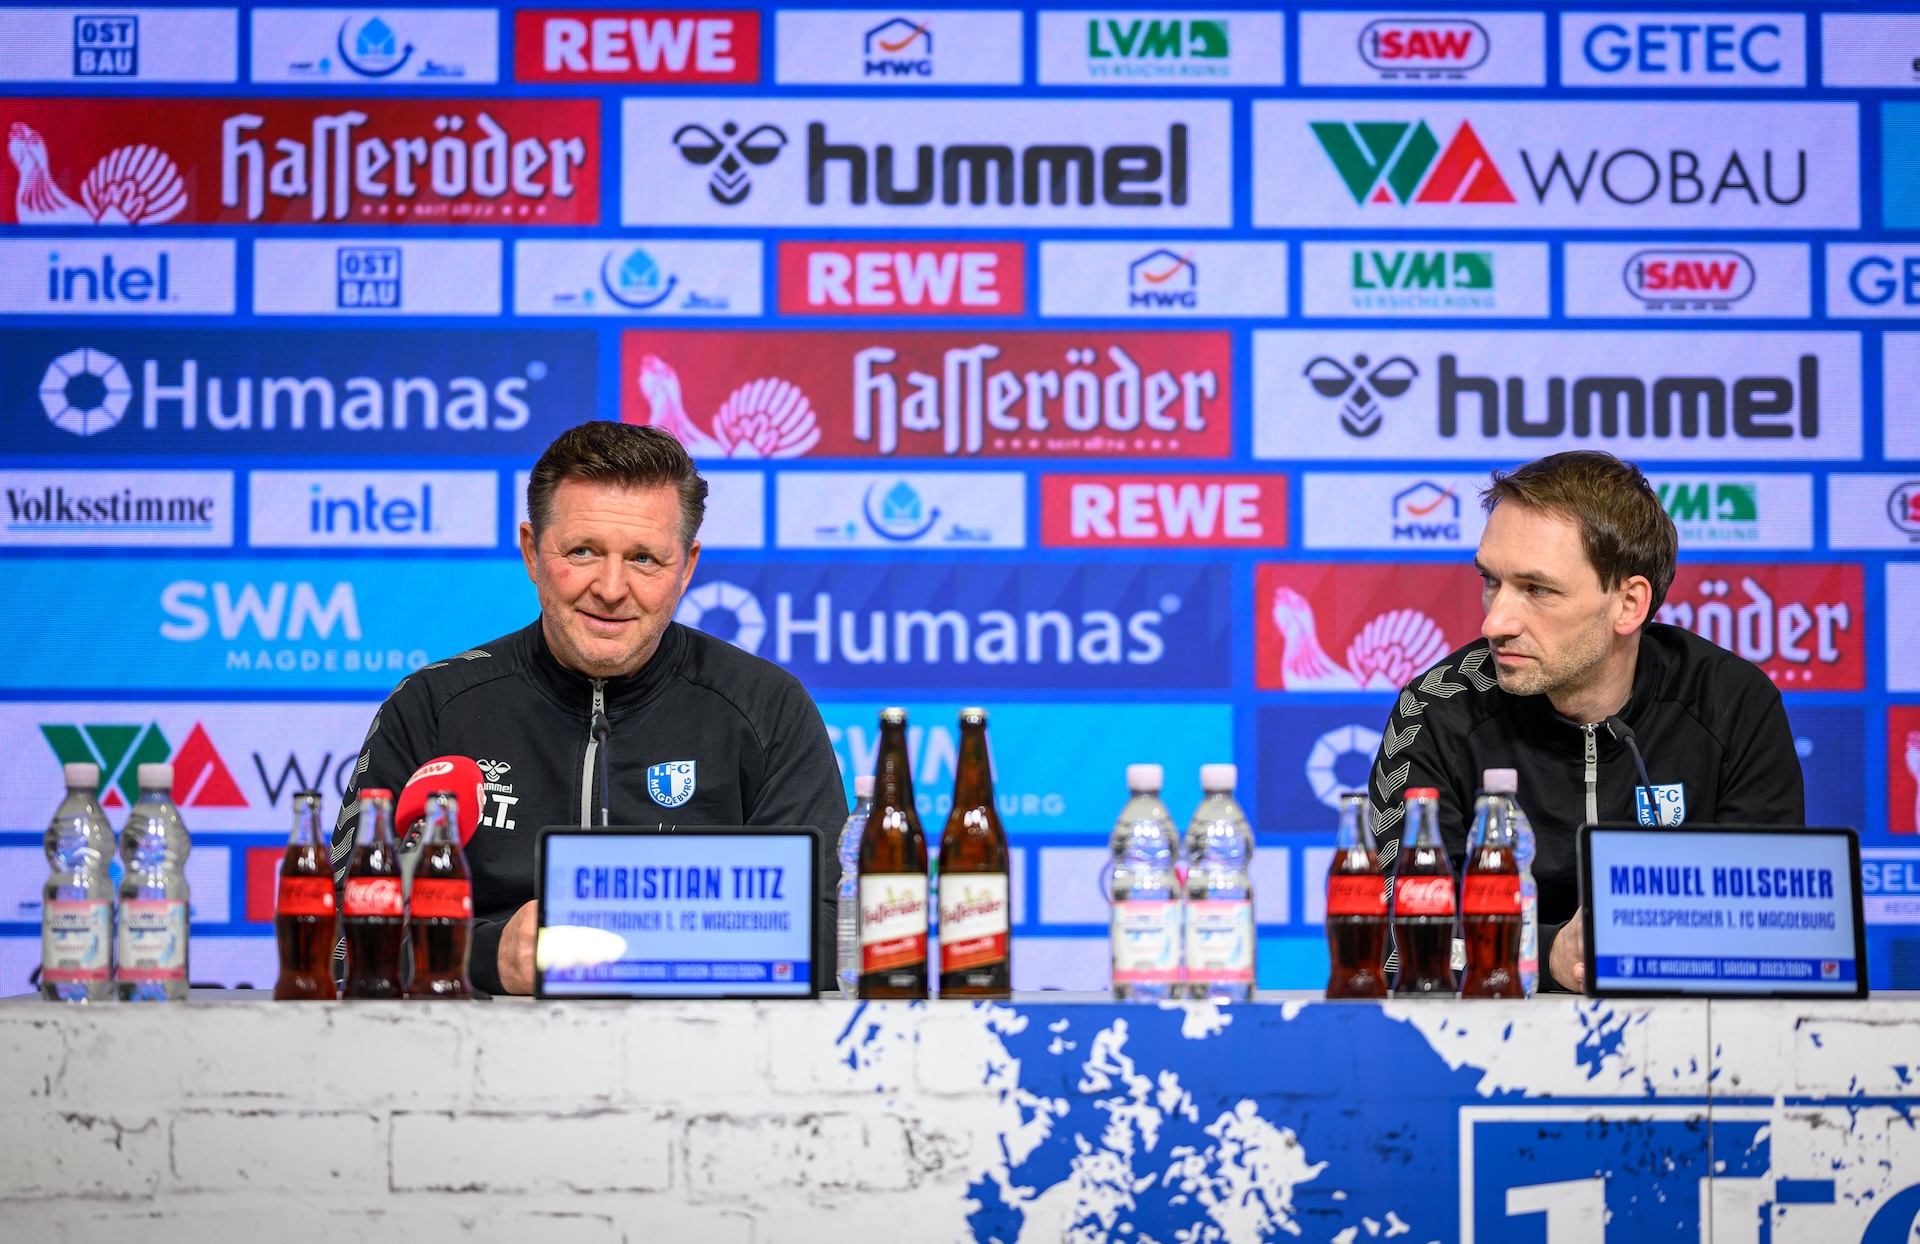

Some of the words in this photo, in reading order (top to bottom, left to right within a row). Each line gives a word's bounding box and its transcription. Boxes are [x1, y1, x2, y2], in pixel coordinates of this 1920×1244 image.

[81, 22, 131, 44] OST
[544, 18, 736, 72] REWE
[1089, 20, 1182, 58] LVM
[1582, 23, 1781, 74] GETEC
[80, 51, 133, 74] BAU
[864, 60, 932, 76] MWG
[807, 121, 1188, 206] hummel
[1519, 149, 1807, 206] WOBAU
[48, 251, 170, 302] intel
[344, 253, 392, 275] OST
[808, 252, 1000, 306] REWE
[1353, 252, 1447, 289] LVM
[341, 282, 397, 307] BAU
[1130, 291, 1197, 308] MWG
[143, 359, 531, 432] Humanas
[1437, 354, 1819, 438] hummel
[6, 487, 214, 523] Volksstimme
[310, 484, 432, 533] intel
[1071, 483, 1262, 538] REWE
[1391, 524, 1460, 541] MWG
[158, 581, 362, 641] SWM
[776, 592, 1165, 665] Humanas
[225, 649, 430, 672] MAGDEBURG
[649, 763, 691, 777] 1.FC
[650, 777, 692, 805] MAGDEBURG
[575, 866, 721, 900] CHRISTIAN
[730, 866, 785, 900] TITZ
[1610, 865, 1705, 897] MANUEL
[1712, 867, 1835, 899] HOLSCHER
[680, 911, 695, 932] FC
[702, 911, 792, 933] MAGDEBURG
[1613, 908, 1723, 929] PRESSESPRECHER
[1740, 910, 1755, 929] FC
[1758, 911, 1836, 931] MAGDEBURG
